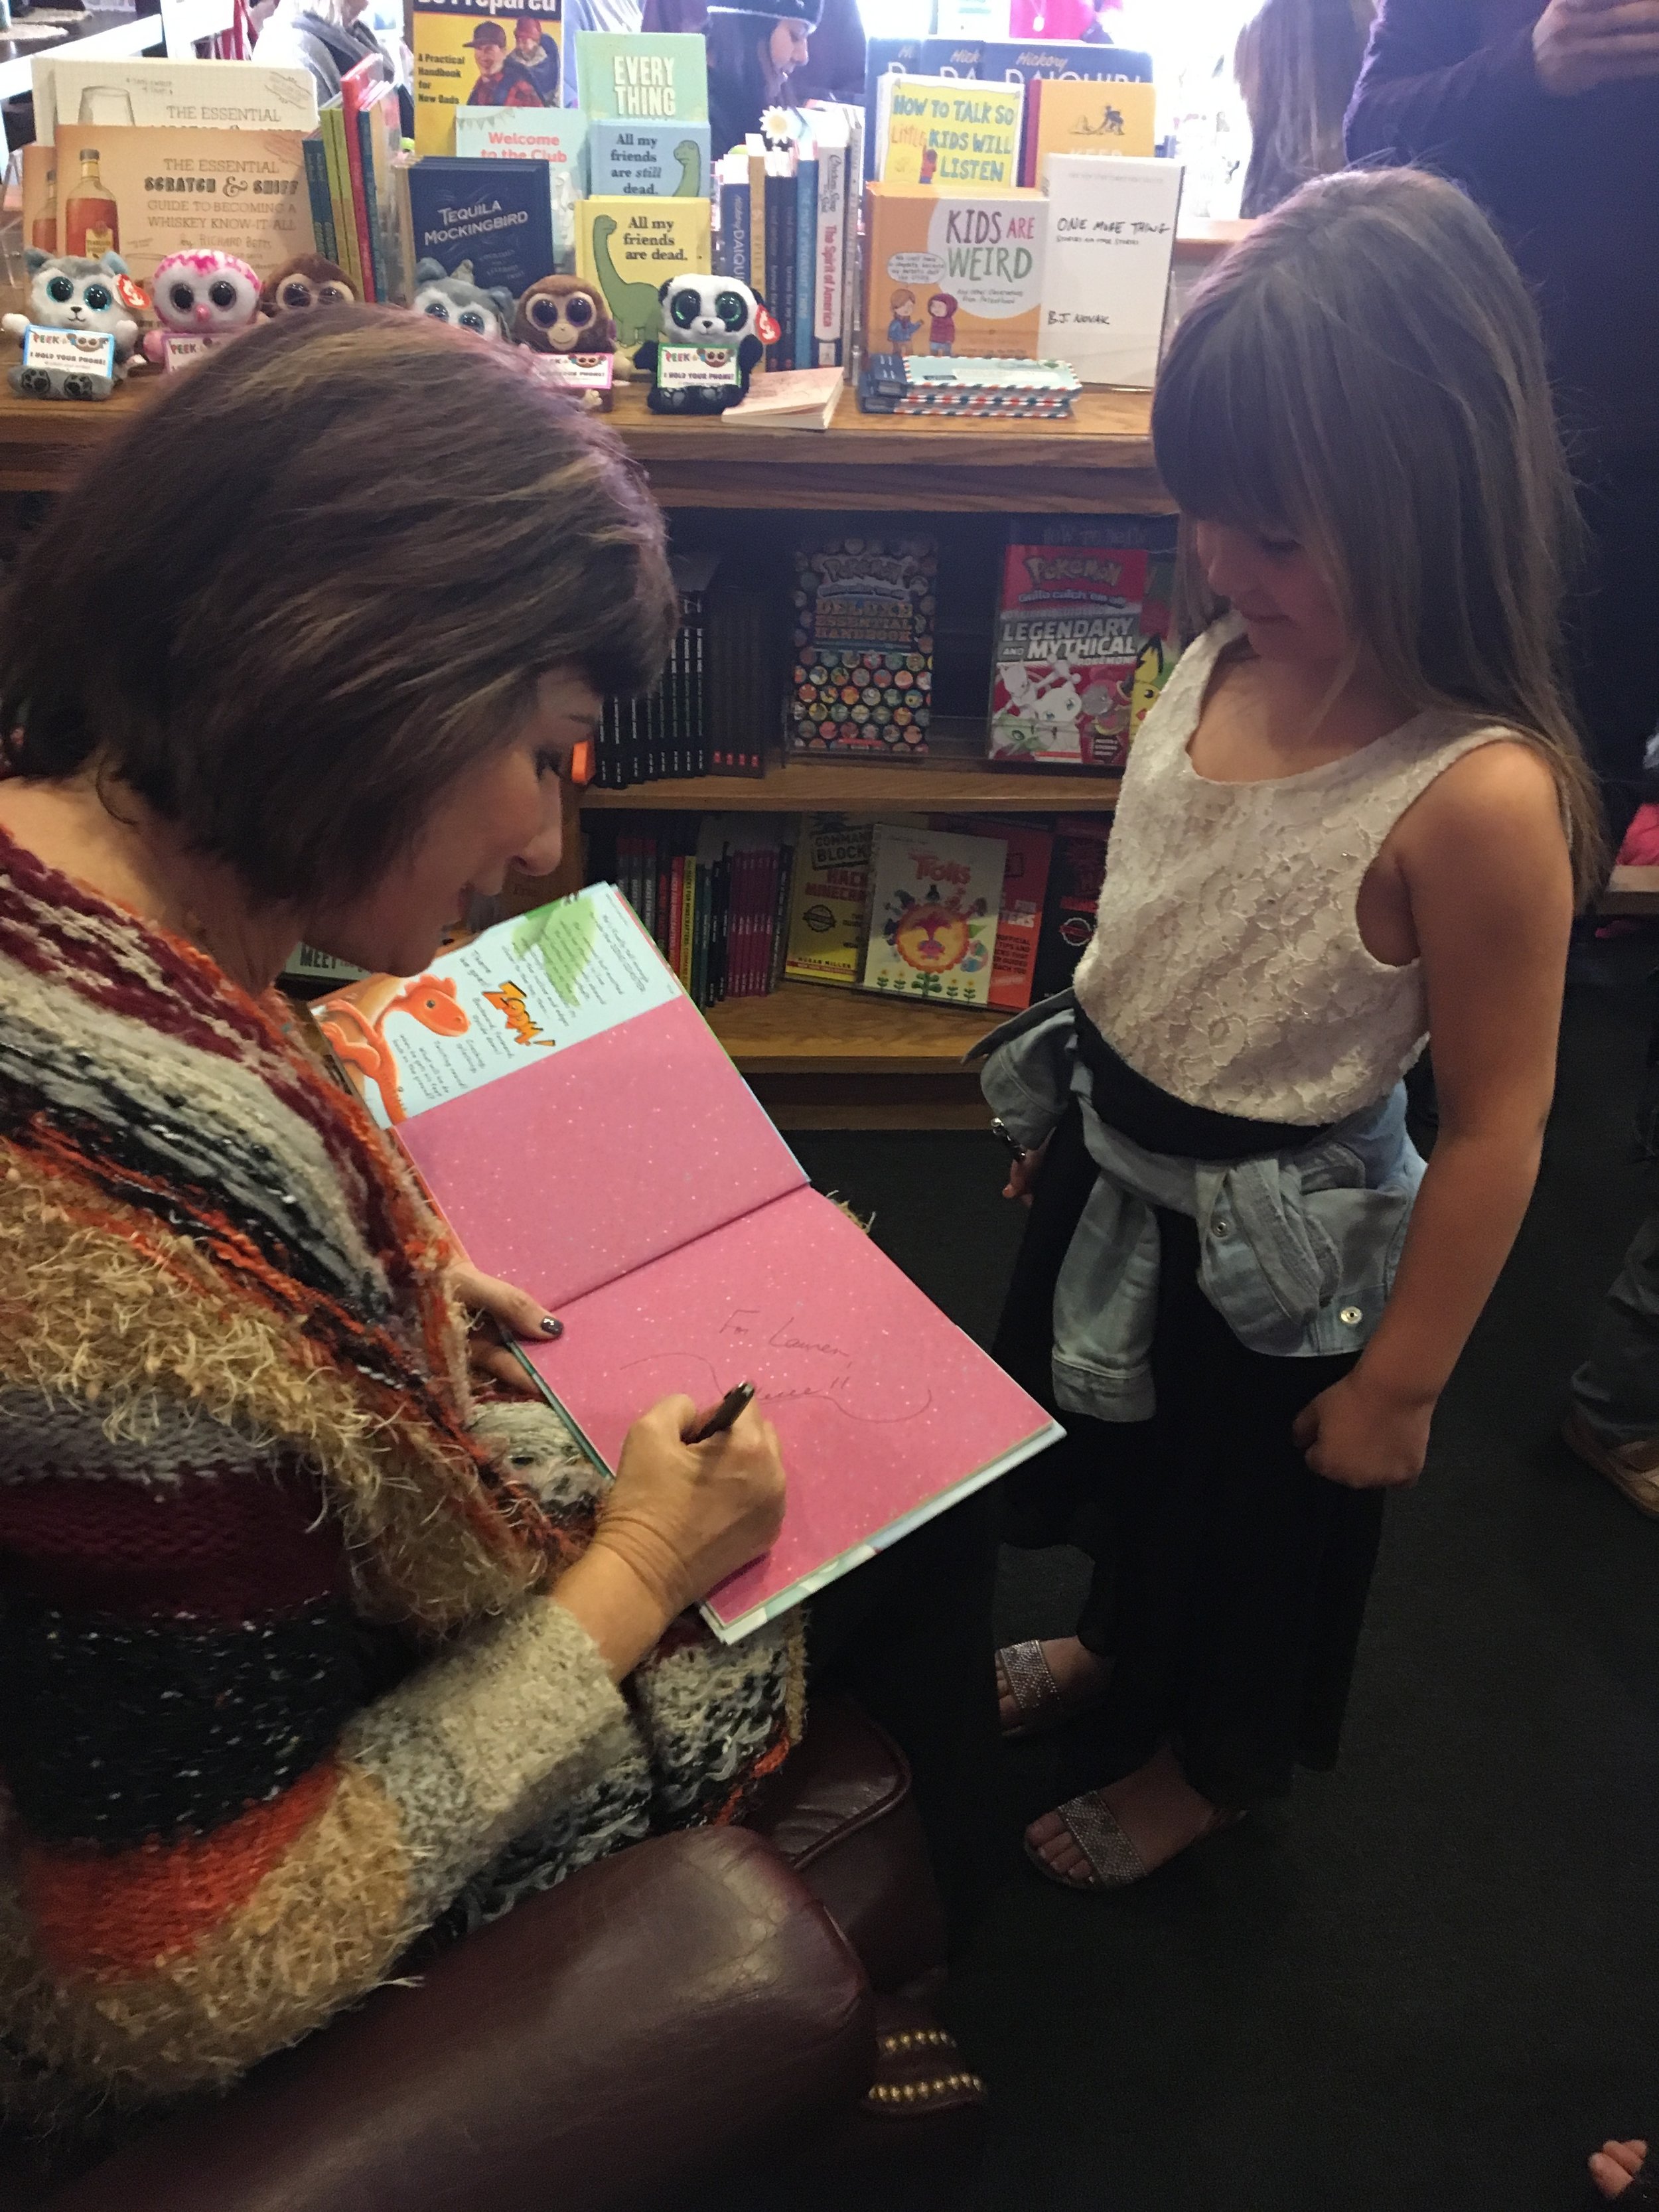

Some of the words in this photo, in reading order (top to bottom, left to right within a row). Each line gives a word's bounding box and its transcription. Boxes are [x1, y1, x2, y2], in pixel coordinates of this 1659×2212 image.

[425, 54, 465, 64] Practical
[418, 68, 461, 78] Handbook
[614, 56, 674, 86] EVERY
[439, 95, 460, 104] Dads
[614, 86, 676, 116] THING
[167, 106, 197, 120] THE
[201, 106, 281, 123] ESSENTIAL
[893, 96, 928, 116] HOW
[931, 99, 950, 117] TO
[953, 100, 991, 124] TALK
[995, 103, 1015, 125] SO
[488, 132, 560, 145] Welcome
[616, 133, 634, 145] All
[638, 137, 658, 149] my
[929, 128, 969, 150] KIDS
[973, 133, 1012, 154] WILL
[481, 149, 497, 159] to
[501, 149, 527, 160] the
[531, 149, 567, 163] Club
[611, 149, 658, 163] friends
[164, 158, 194, 172] THE
[198, 159, 280, 175] ESSENTIAL
[611, 169, 632, 178] are
[635, 167, 662, 179] still
[940, 156, 1005, 182] LISTEN
[144, 176, 216, 193] SCRATCH
[222, 175, 248, 198] &
[623, 183, 659, 194] dead.
[800, 188, 811, 204] THE
[147, 200, 189, 212] GUIDE
[192, 200, 212, 212] TO
[213, 201, 283, 214] BECOMING
[287, 203, 297, 214] A
[437, 200, 502, 226] TEQUILA
[147, 216, 208, 229] WHISKEY
[424, 211, 529, 246] MOCKINGBIRD
[628, 216, 648, 229] All
[652, 220, 675, 233] my
[946, 209, 1002, 244] KIDS
[1006, 217, 1035, 240] ARE
[1057, 218, 1088, 232] ONE
[1093, 220, 1126, 234] MORE
[1131, 221, 1171, 235] THING
[199, 235, 242, 248] RICHARD
[623, 234, 676, 246] friends
[825, 224, 837, 244] The
[625, 252, 648, 260] are
[651, 249, 688, 261] dead.
[733, 229, 745, 281] DAIQUI
[822, 246, 836, 273] Spirit
[947, 247, 1033, 283] WEIRD
[824, 274, 835, 285] of
[824, 286, 835, 328] America
[33, 334, 60, 344] PEEK
[170, 342, 198, 355] PEEK
[665, 351, 690, 362] PEEK
[35, 352, 54, 360] HOLD
[56, 354, 77, 362] YOUR
[78, 356, 107, 365] PHONE!
[817, 599, 913, 618] DELUXE
[1003, 617, 1135, 640] LEGENDARY
[1027, 636, 1137, 660] MYTHICAL
[482, 980, 556, 1047] ZOOM!
